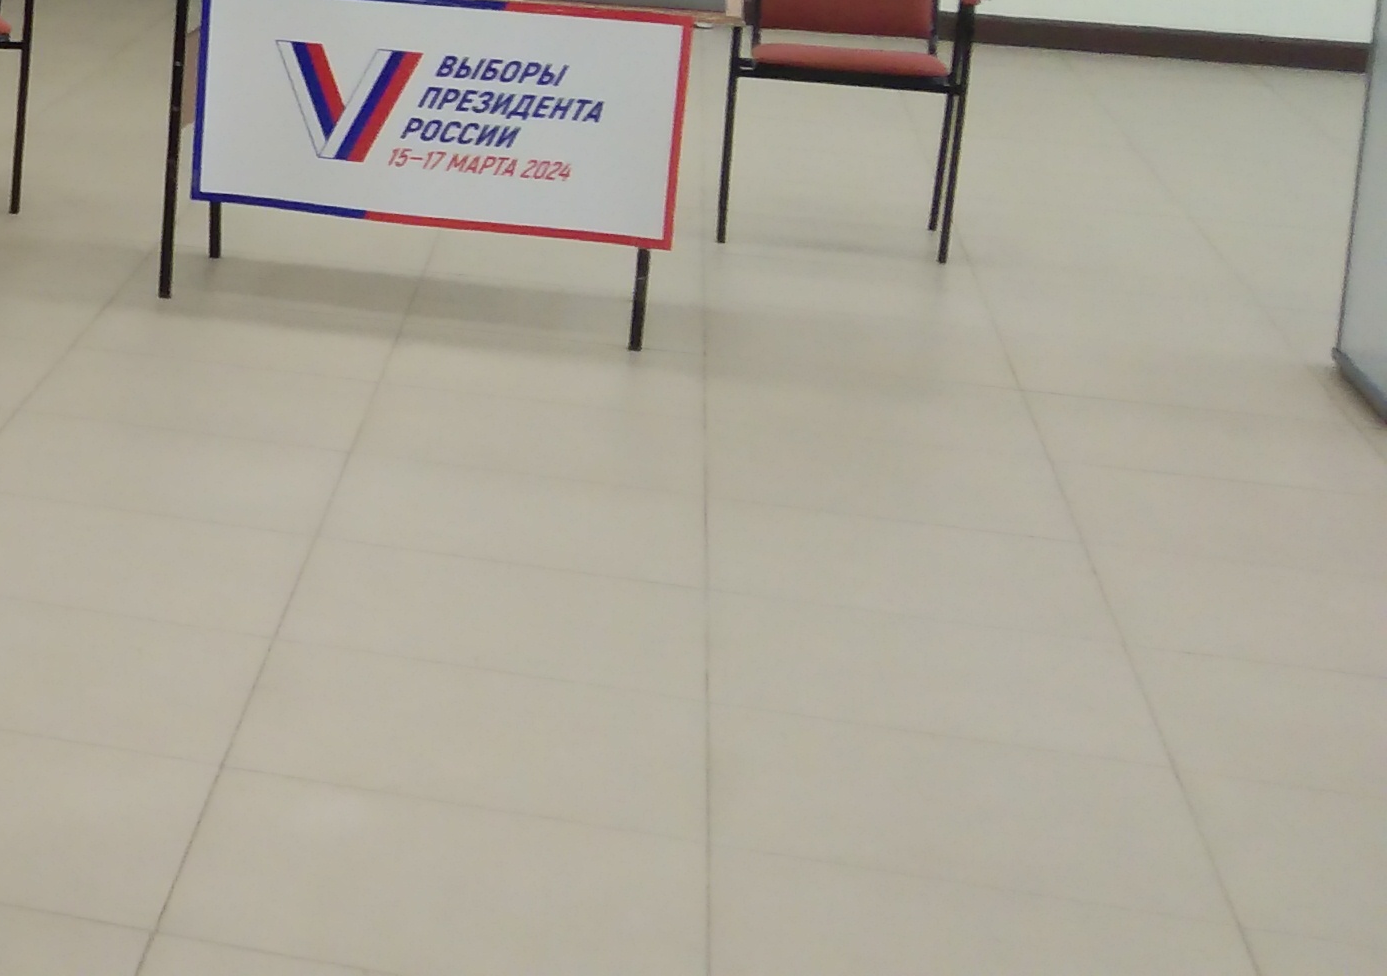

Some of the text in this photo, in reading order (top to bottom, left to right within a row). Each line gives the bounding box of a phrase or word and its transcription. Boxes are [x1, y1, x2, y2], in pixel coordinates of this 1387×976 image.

[435, 54, 570, 87] ВЫБОРЫ
[417, 86, 605, 124] ПРЕЗИДЕНТА
[399, 117, 522, 149] РОССИИ
[446, 153, 519, 177] МАРТА
[519, 159, 572, 182] 2024
